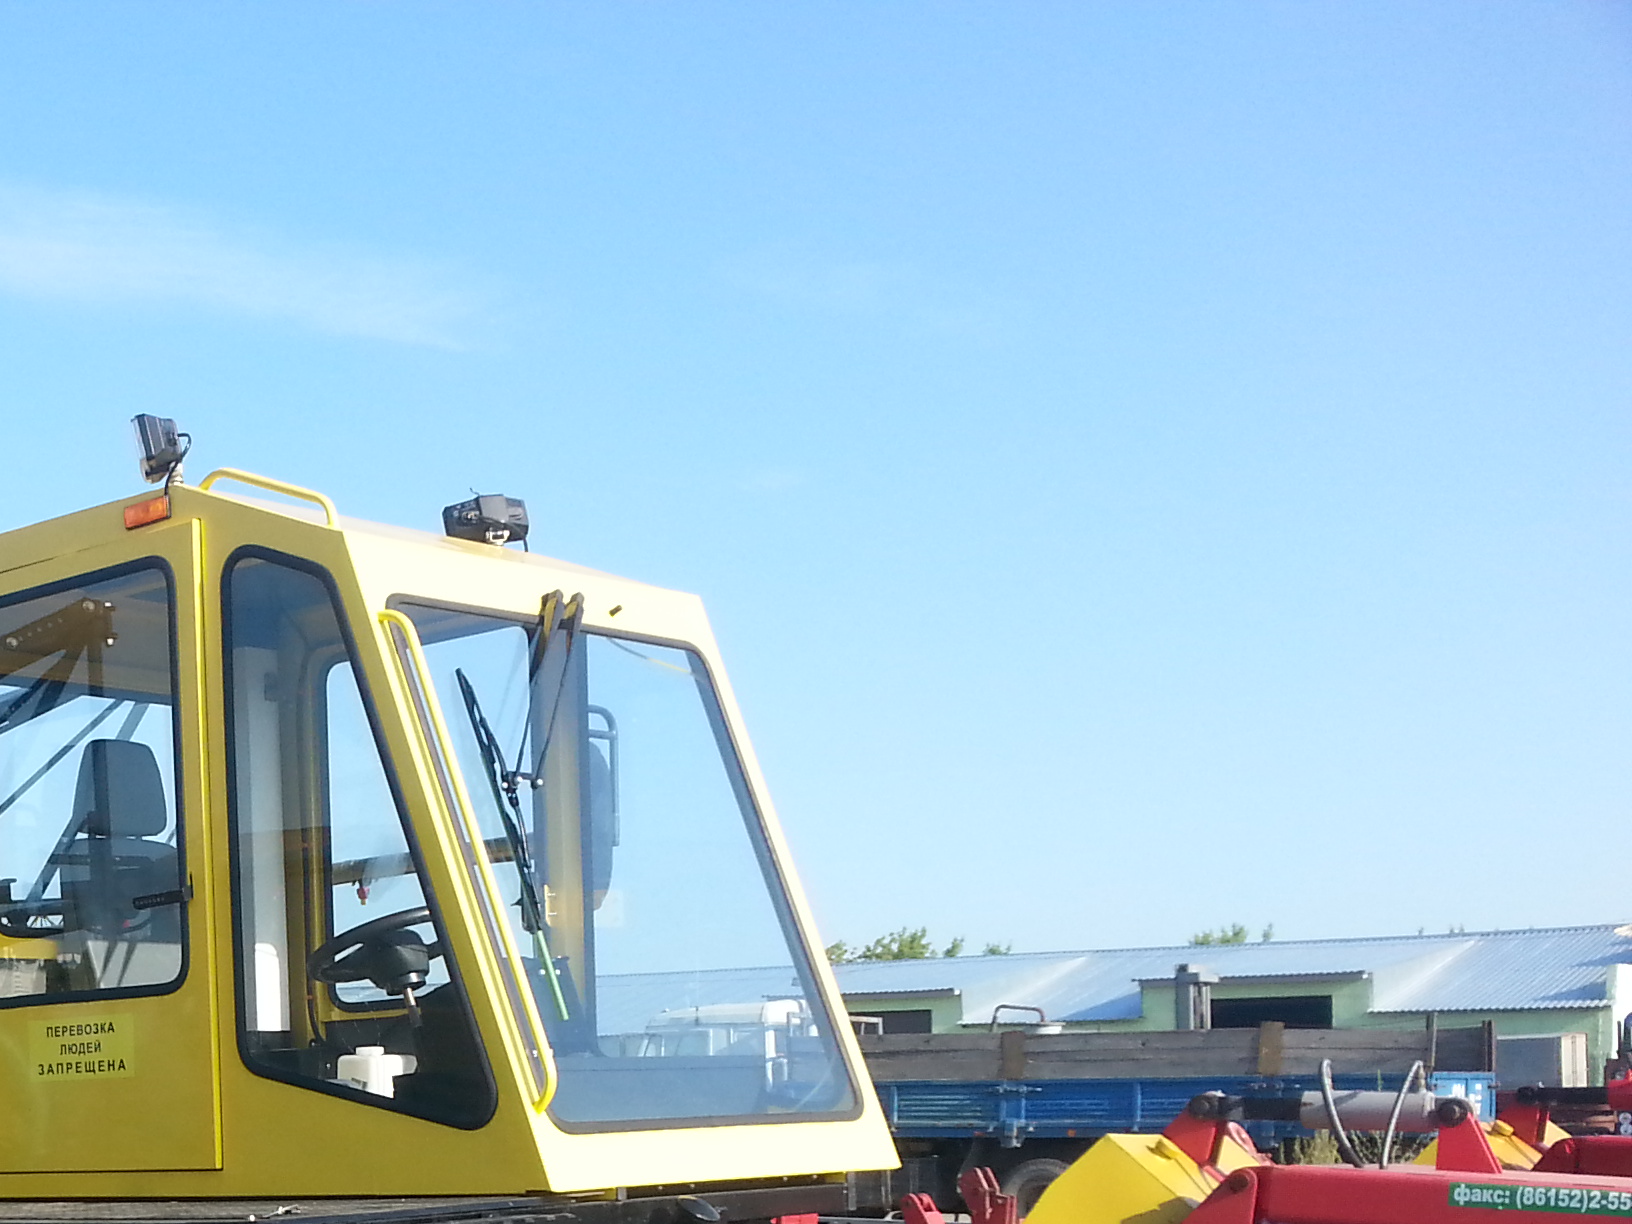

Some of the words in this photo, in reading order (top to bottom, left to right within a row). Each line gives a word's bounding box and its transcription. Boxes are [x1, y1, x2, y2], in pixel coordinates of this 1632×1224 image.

[46, 1022, 115, 1038] ПЕРЕВОЗКА
[60, 1039, 101, 1056] ЛЮДЕЙ
[38, 1059, 126, 1076] ЗАПРЕЩЕНА
[1453, 1183, 1510, 1206] факс:
[1516, 1186, 1632, 1213] (86152)2-55
